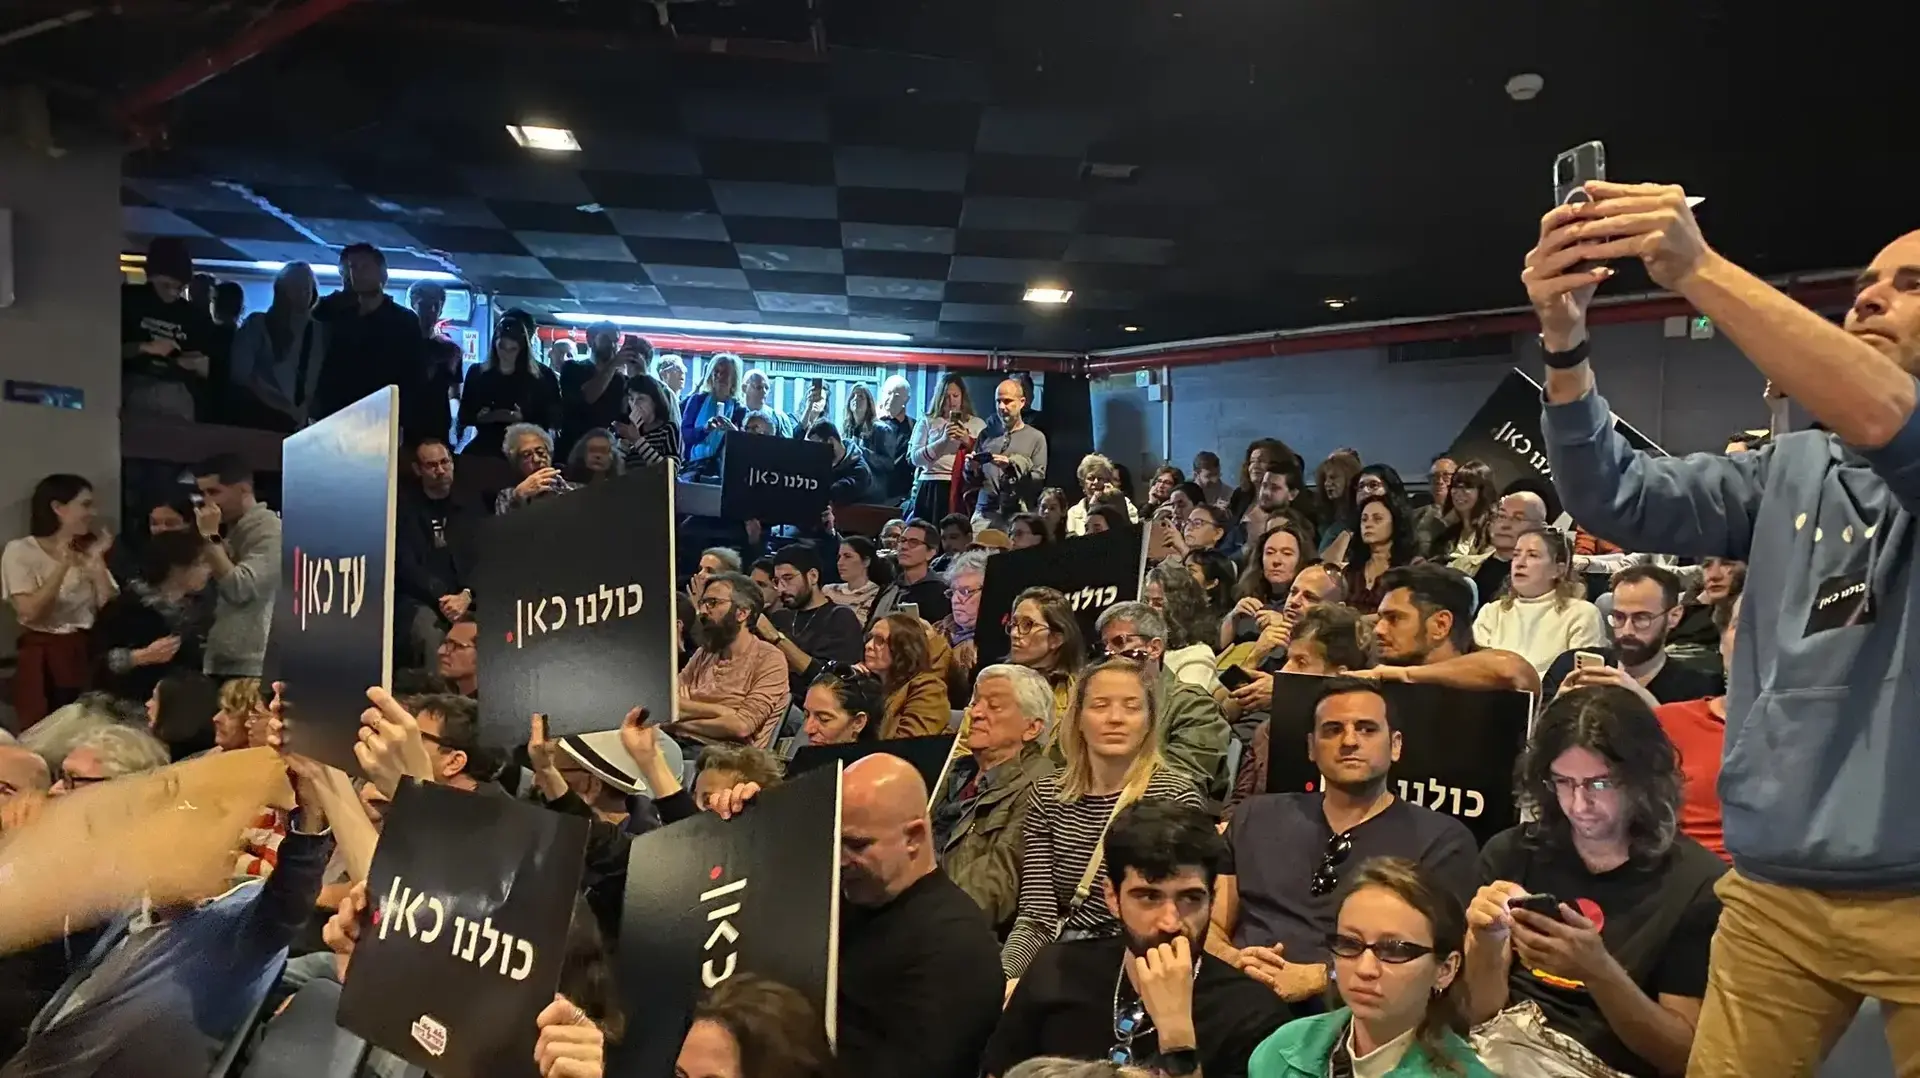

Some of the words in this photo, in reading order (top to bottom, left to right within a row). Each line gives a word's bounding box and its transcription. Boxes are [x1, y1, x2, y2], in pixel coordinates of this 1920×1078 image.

[784, 475, 818, 490] כולנו
[293, 545, 334, 632] כאן!
[339, 555, 366, 619] עד
[575, 583, 644, 627] כולנו
[1841, 583, 1866, 599] כולנו
[451, 916, 534, 981] כולנו
